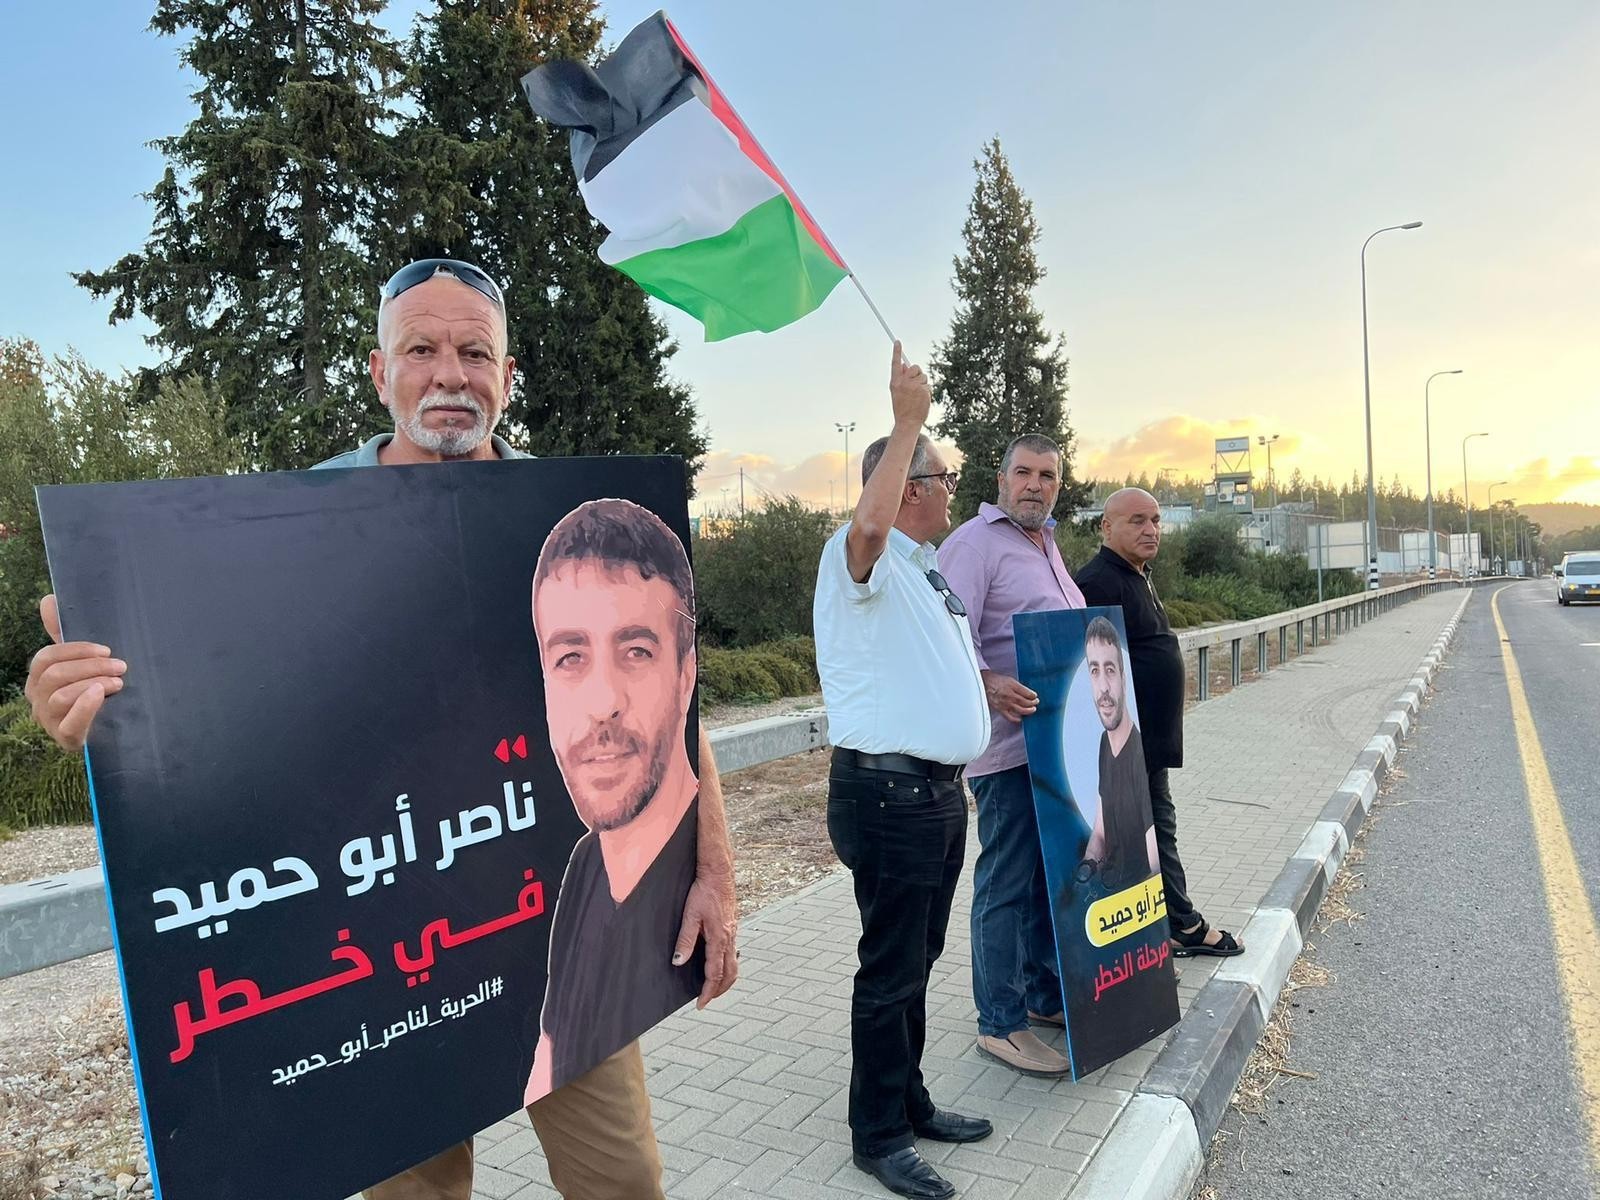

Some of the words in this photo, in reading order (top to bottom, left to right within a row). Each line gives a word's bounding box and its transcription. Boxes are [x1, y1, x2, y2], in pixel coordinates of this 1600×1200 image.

[340, 793, 417, 897] أبو
[436, 780, 536, 871] ناصر
[152, 856, 319, 939] حميد
[393, 868, 545, 988] في
[1098, 906, 1134, 935] حميد
[1136, 884, 1151, 923] أبو
[169, 928, 374, 1063] خطر
[1094, 951, 1134, 1001] الخطر
[1137, 940, 1169, 971] مرحلة
